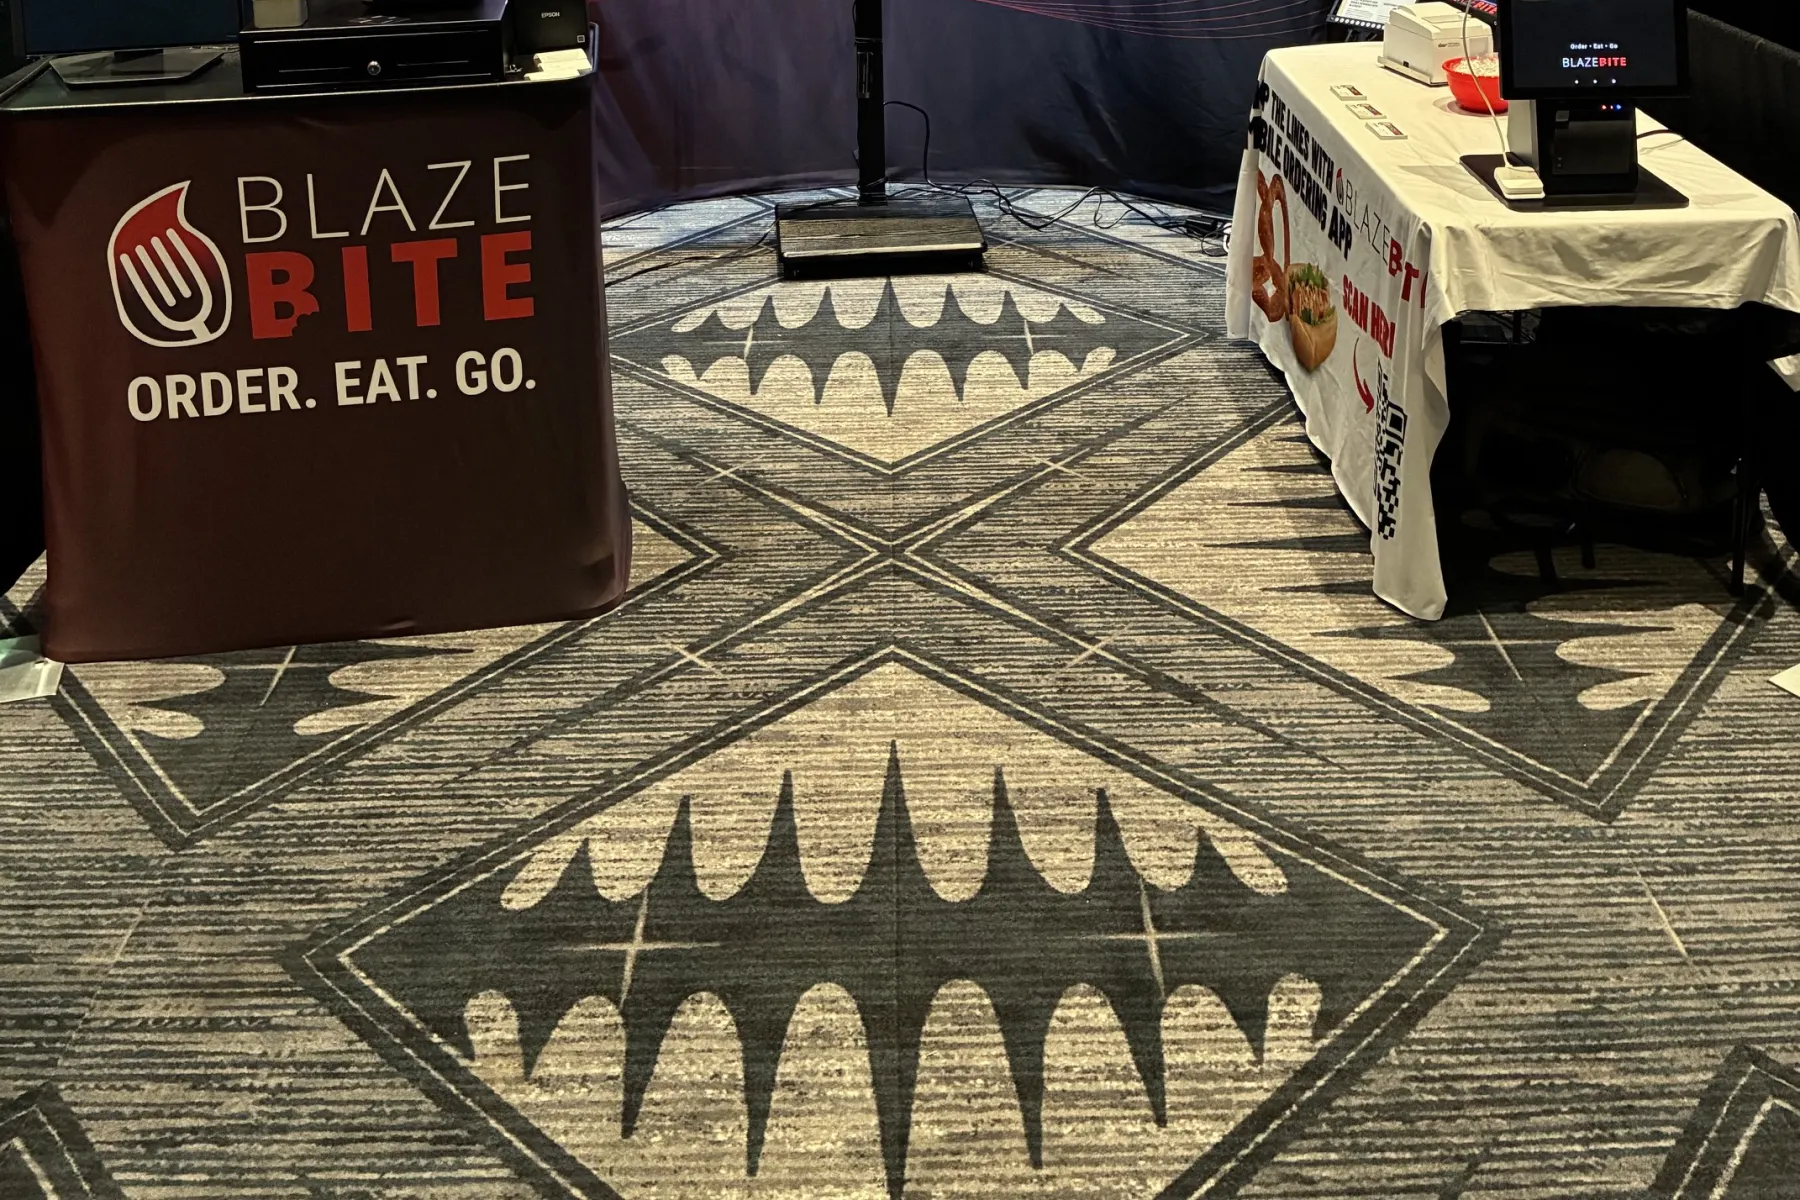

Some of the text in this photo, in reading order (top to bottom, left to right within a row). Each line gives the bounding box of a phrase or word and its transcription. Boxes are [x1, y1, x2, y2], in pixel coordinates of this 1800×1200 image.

[541, 11, 560, 19] EPSON
[1562, 57, 1627, 68] BLAZEBITE
[1271, 89, 1286, 133] THE
[1286, 108, 1310, 162] LINES
[1311, 136, 1335, 194] WITH
[237, 154, 532, 244] BLAZE
[1250, 117, 1282, 170] BILE
[1283, 144, 1328, 232] ORDERING
[1328, 205, 1353, 261] APP
[245, 230, 535, 340] BITE
[1342, 274, 1369, 334] SCAN
[127, 347, 537, 422] ORDER. EAT. GO.
